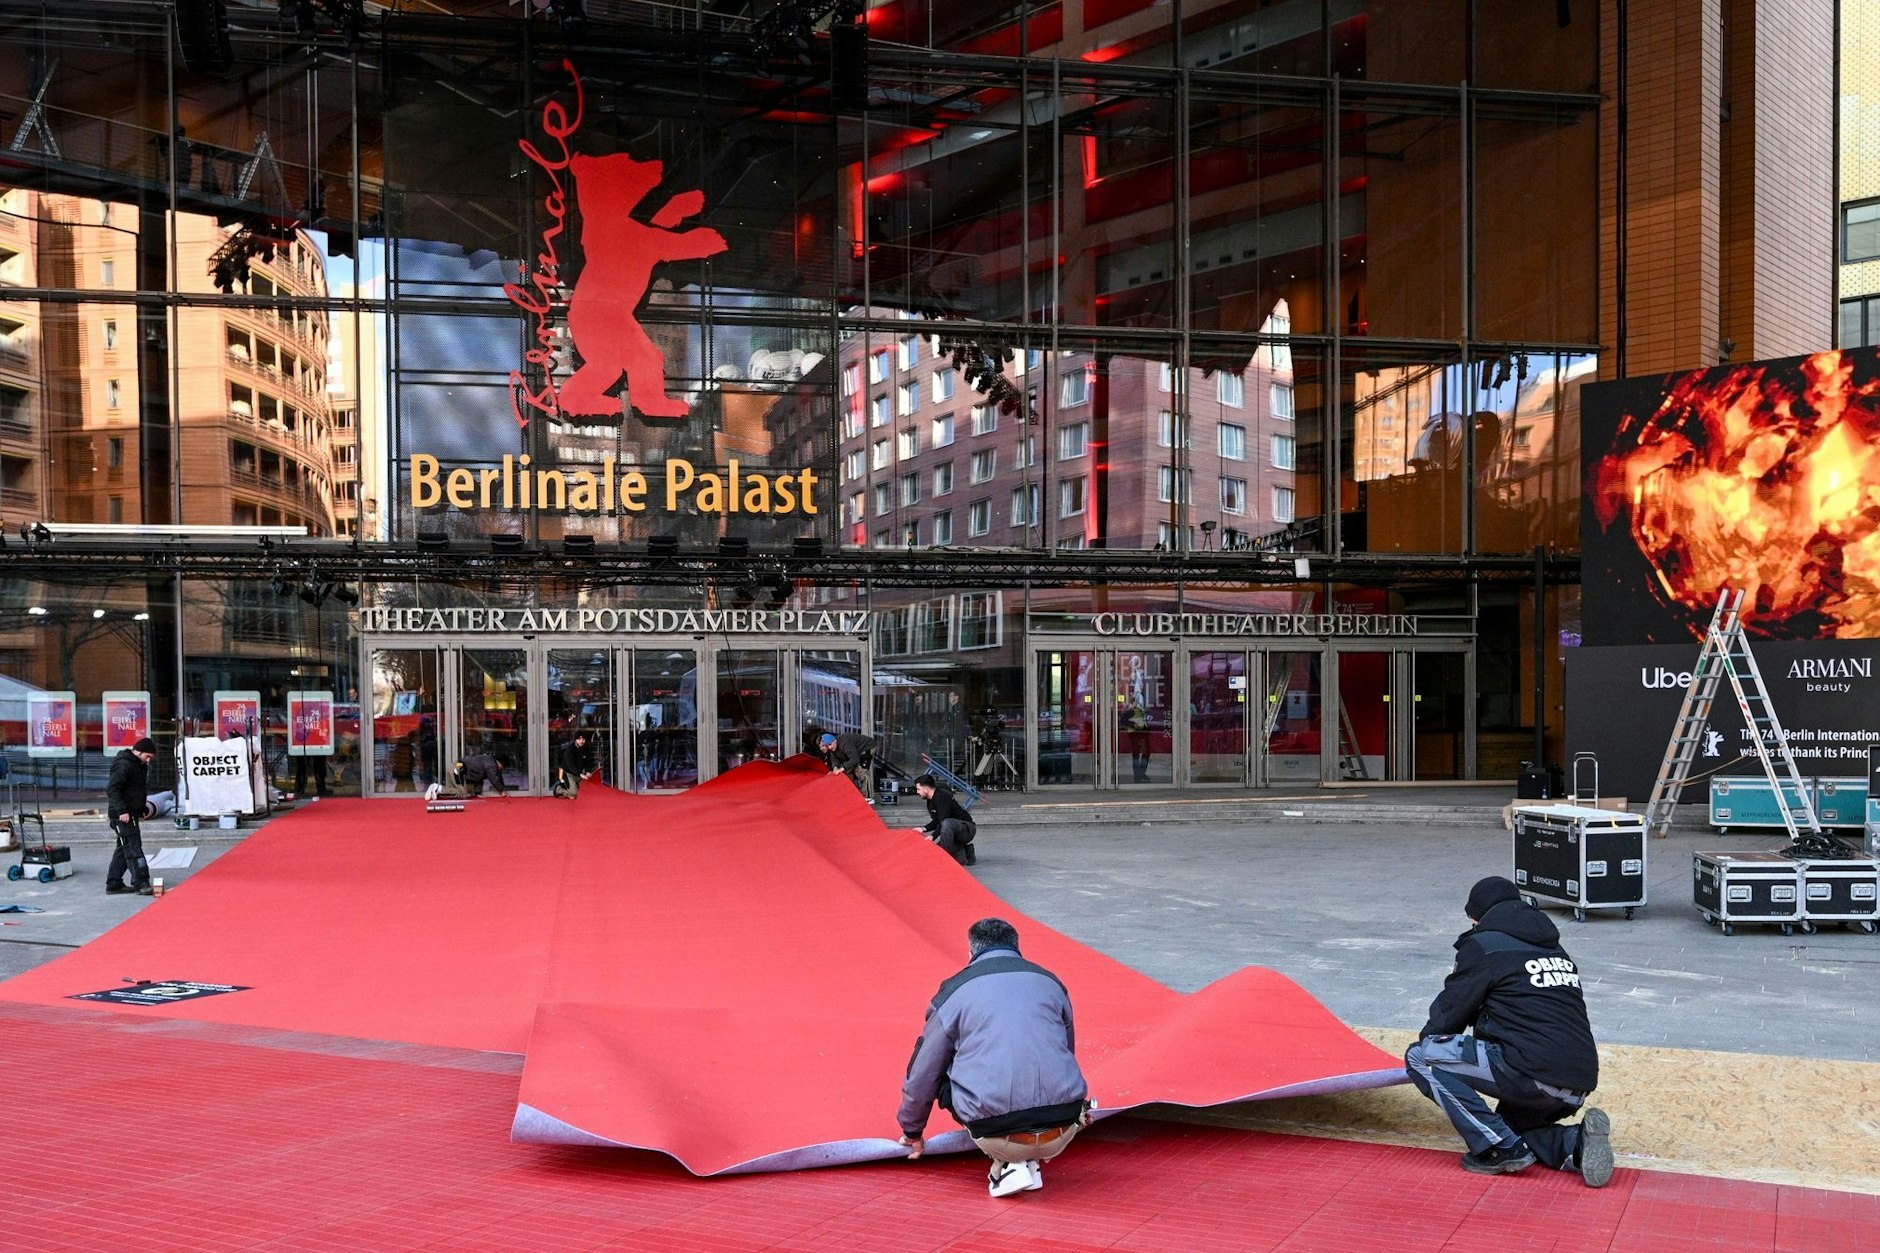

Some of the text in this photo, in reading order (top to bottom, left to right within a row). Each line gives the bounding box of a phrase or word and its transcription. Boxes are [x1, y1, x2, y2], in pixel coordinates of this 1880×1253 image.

[410, 453, 818, 514] Berlinale Palast
[359, 608, 870, 632] THEATER AM POTSDAMER PLATZ
[1094, 612, 1418, 636] CLUB THEATER BERLIN
[1787, 657, 1872, 679] ARMANI
[1641, 667, 1694, 689] Ube
[1806, 682, 1851, 693] beauty
[1740, 728, 1879, 740] Th 74 Berlin Internation
[192, 755, 239, 766] OBJECT
[1790, 746, 1822, 758] thank
[1824, 747, 1838, 758] its
[1840, 747, 1868, 758] Princ
[192, 766, 241, 776] CARPET
